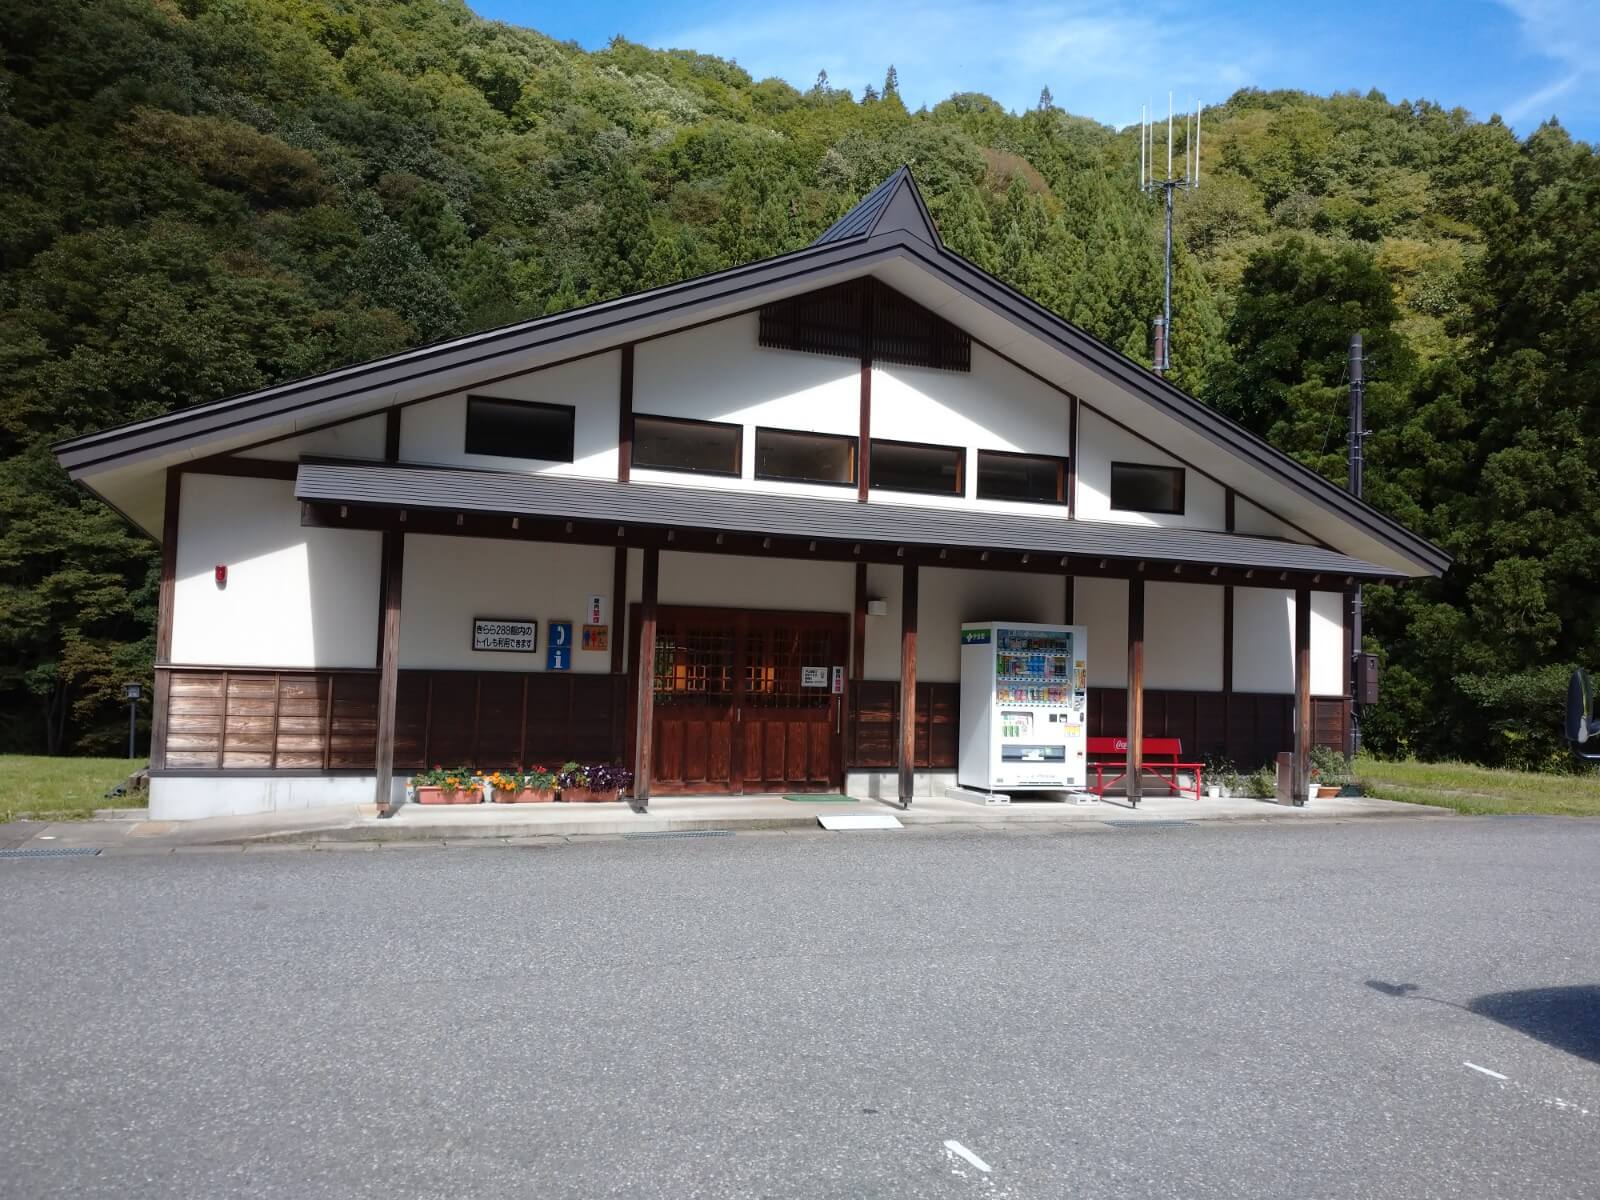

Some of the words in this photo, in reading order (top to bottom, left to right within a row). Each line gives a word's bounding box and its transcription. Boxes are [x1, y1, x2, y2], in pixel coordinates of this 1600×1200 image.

[476, 637, 532, 649] トイレも利用できます
